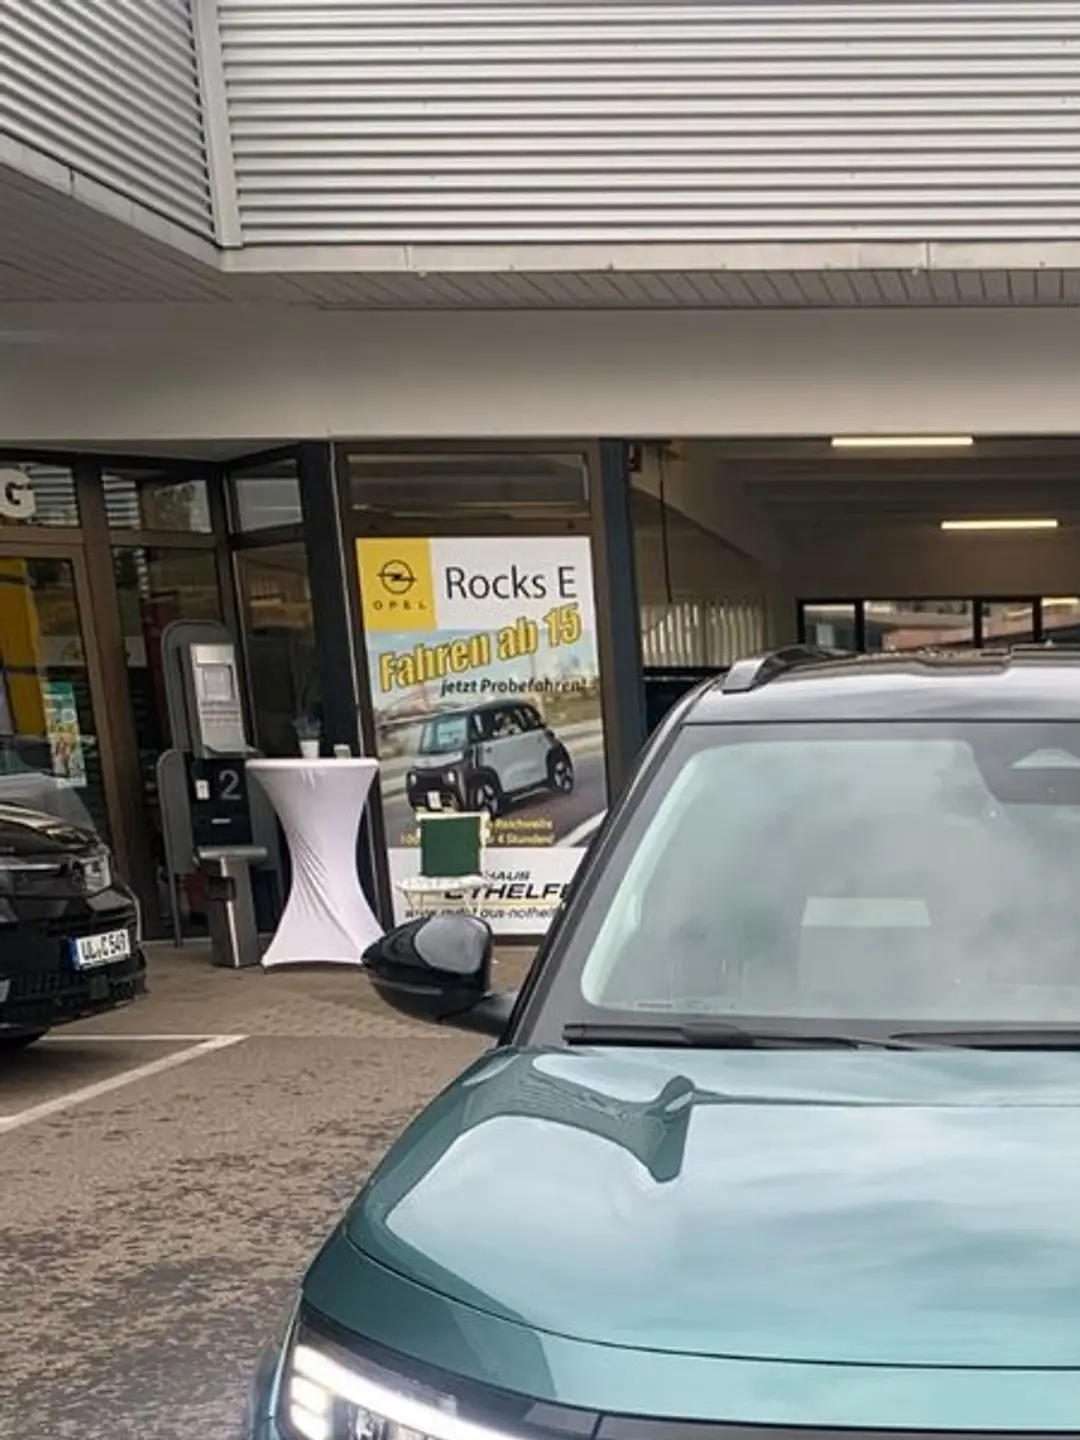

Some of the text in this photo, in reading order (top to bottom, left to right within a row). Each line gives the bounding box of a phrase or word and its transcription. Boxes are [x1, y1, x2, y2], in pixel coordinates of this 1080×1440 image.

[445, 565, 577, 599] Rocks E
[372, 600, 427, 611] OPEL
[378, 601, 583, 692] Fahren ab 15
[440, 676, 587, 697] jetzt Probefahren!
[219, 769, 242, 799] 2
